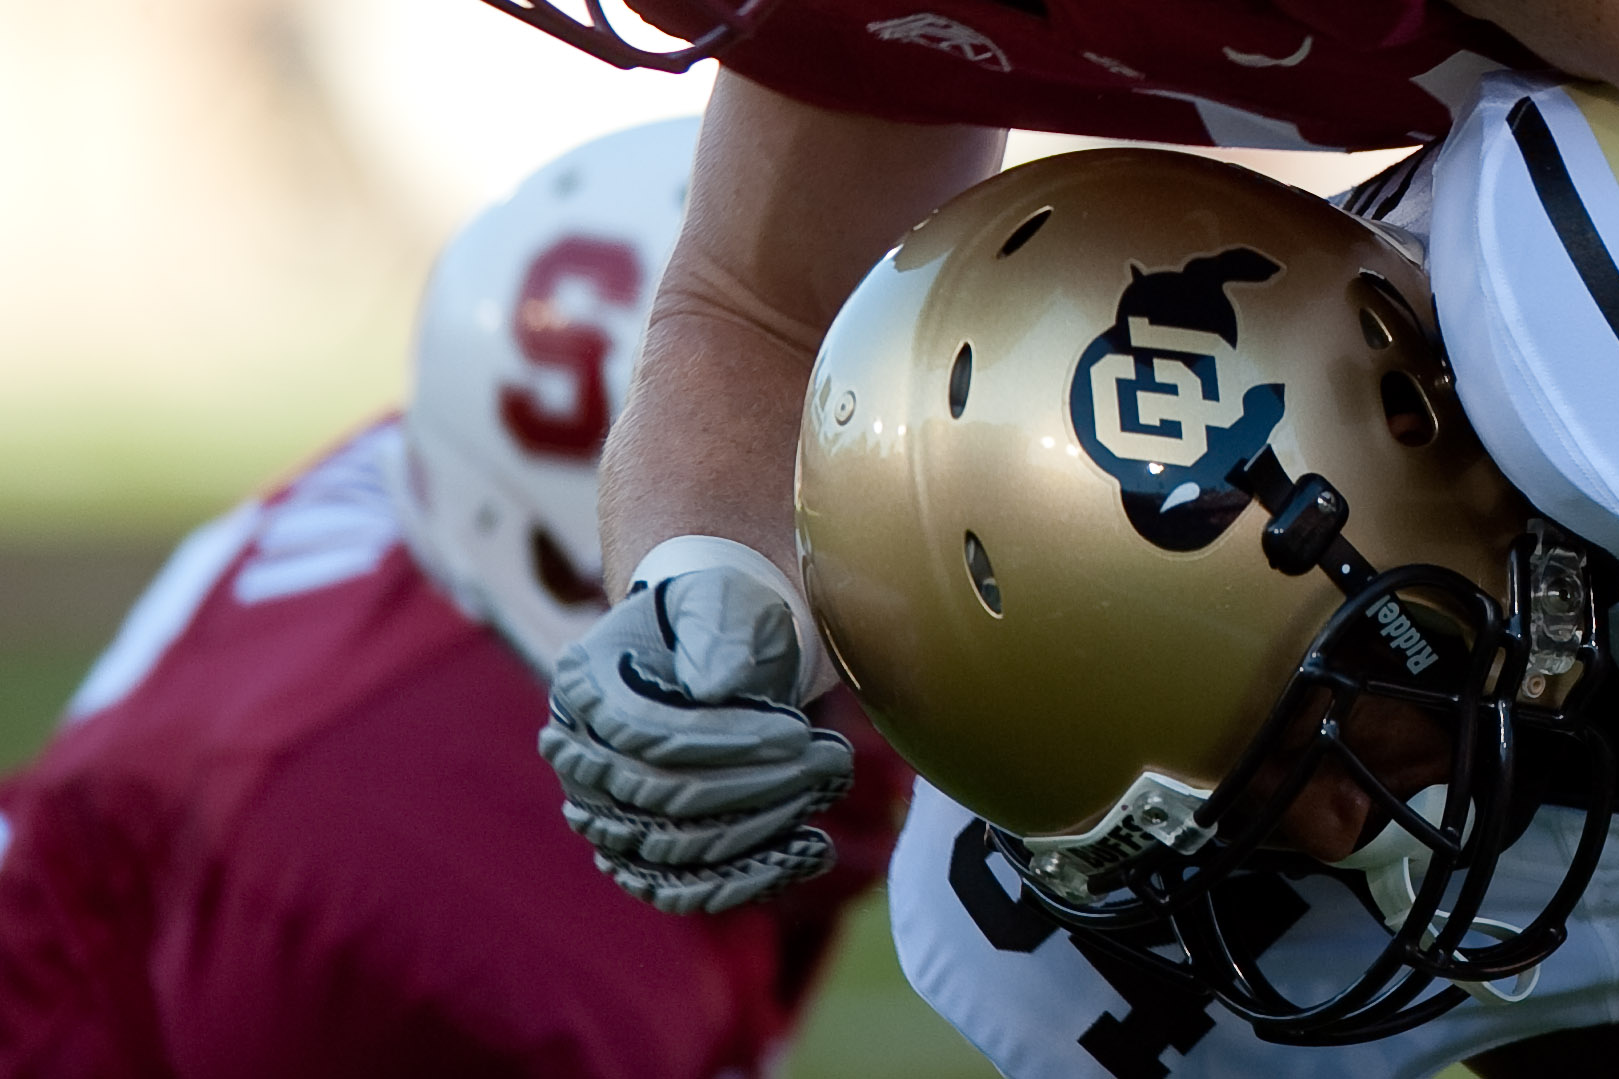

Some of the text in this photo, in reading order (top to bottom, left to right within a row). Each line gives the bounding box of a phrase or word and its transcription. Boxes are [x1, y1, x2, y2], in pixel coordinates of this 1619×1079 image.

[500, 236, 643, 461] S
[1090, 316, 1244, 467] CU
[1365, 594, 1439, 675] Riddel
